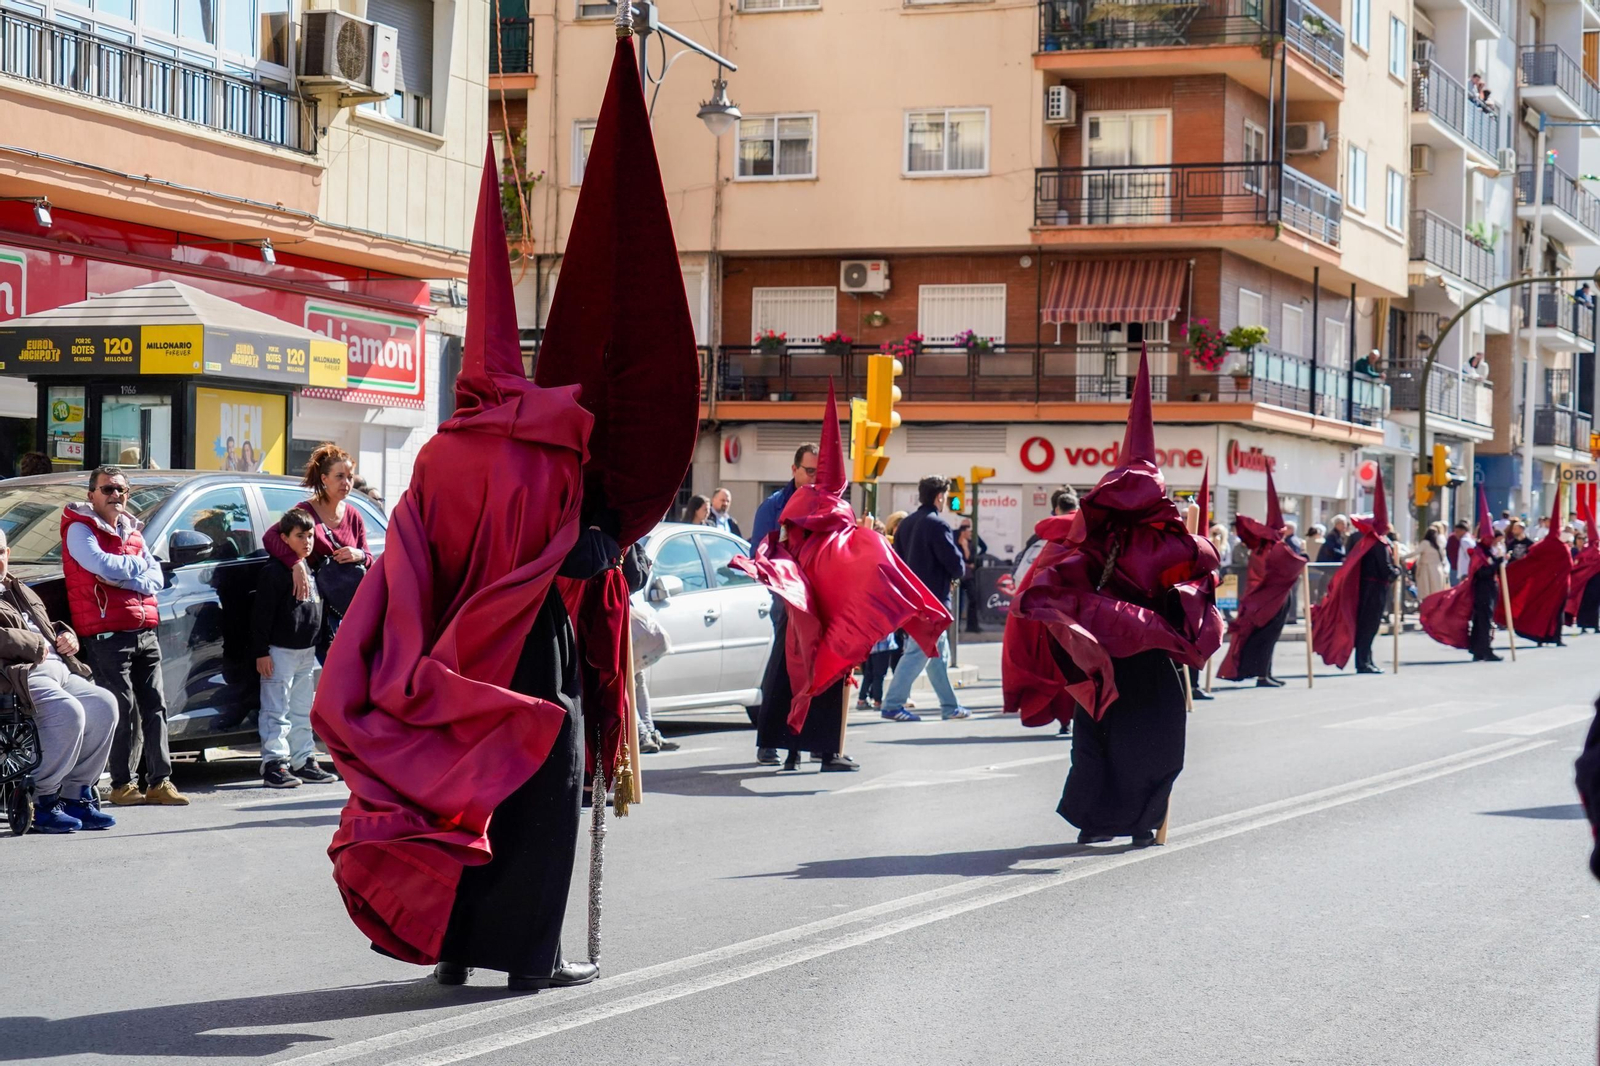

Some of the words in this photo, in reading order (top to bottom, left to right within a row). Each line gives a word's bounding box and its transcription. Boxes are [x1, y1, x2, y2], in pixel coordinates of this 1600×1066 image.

[26, 339, 53, 350] EURO
[71, 345, 95, 355] BOTES
[103, 337, 133, 355] 120
[146, 341, 192, 350] MILLONARIO
[19, 349, 61, 362] JACKPOT
[265, 353, 282, 363] BOTES
[286, 348, 305, 366] 120
[313, 355, 341, 365] MILLONARIO
[120, 385, 137, 395] 1966
[220, 403, 262, 450] BIEN
[1064, 441, 1204, 468] vodone
[1562, 469, 1597, 481] ORO
